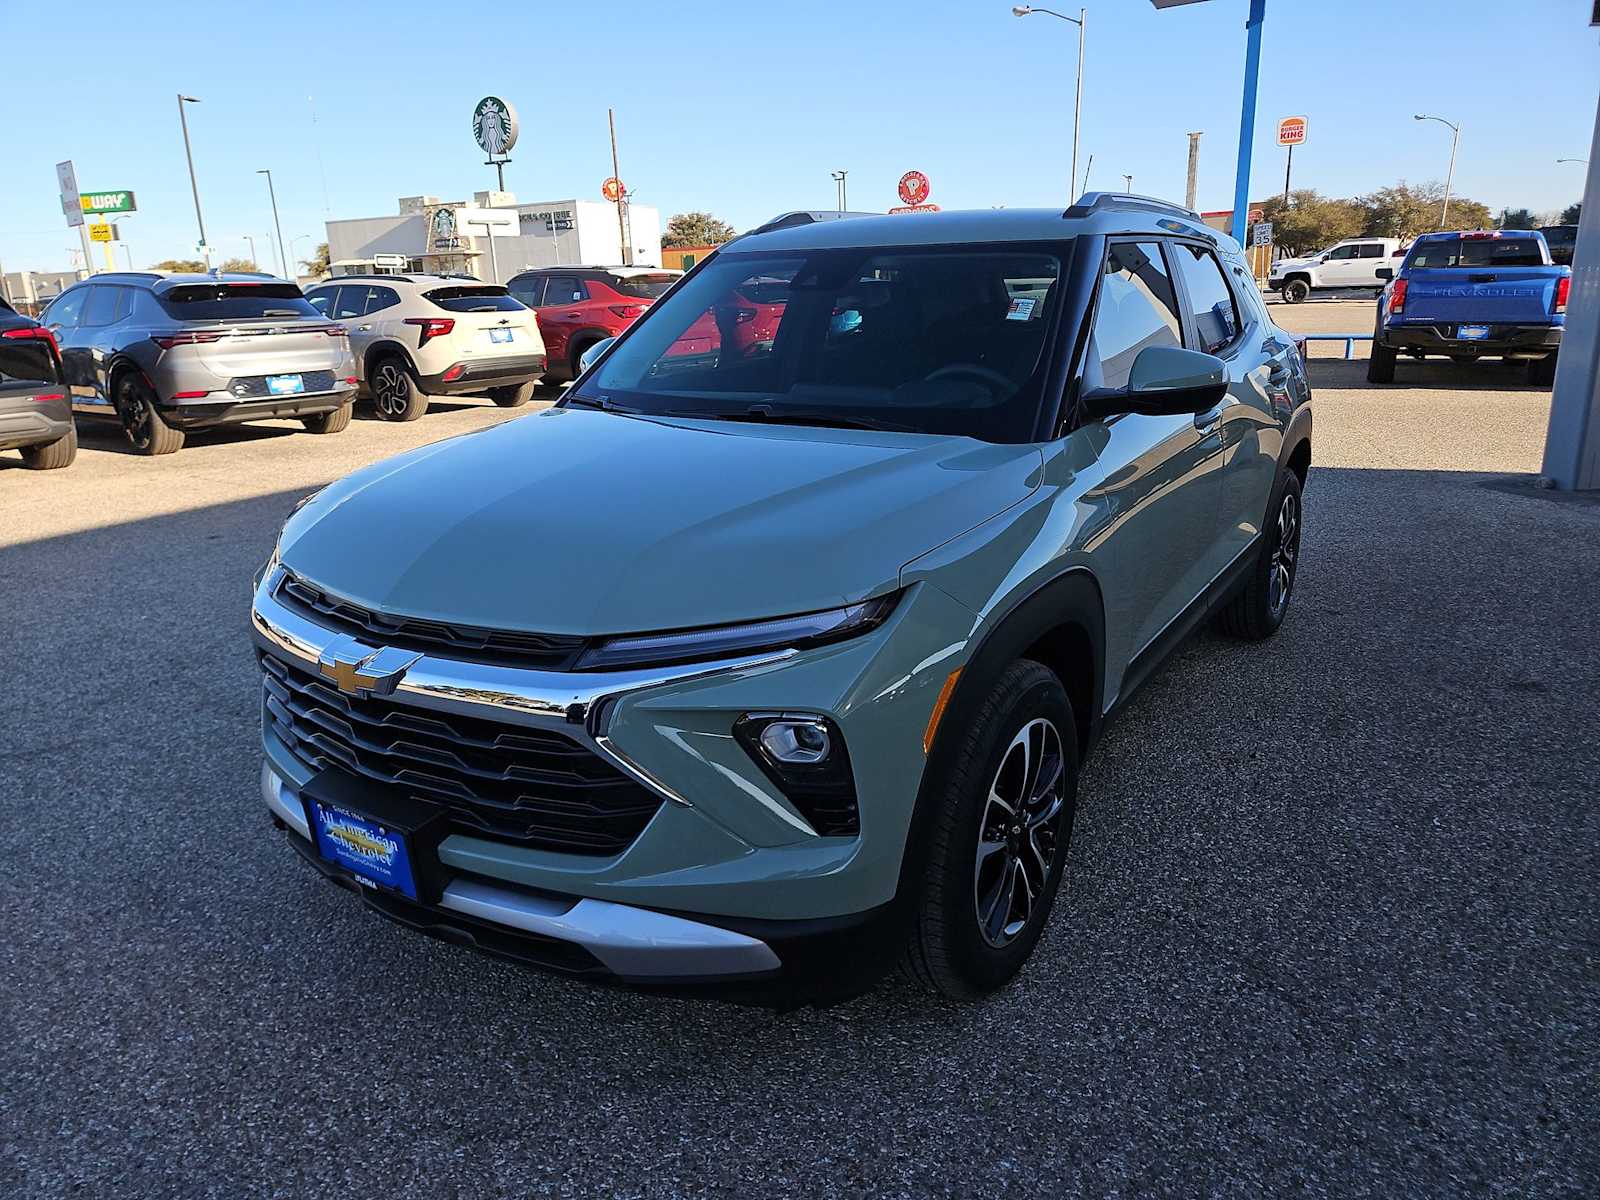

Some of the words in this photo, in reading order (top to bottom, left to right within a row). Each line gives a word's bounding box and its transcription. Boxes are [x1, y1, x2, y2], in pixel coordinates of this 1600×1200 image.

[1280, 131, 1303, 139] KING
[80, 193, 126, 209] BWAY
[1256, 236, 1270, 244] 35
[319, 810, 334, 824] All
[338, 819, 399, 852] American
[331, 831, 393, 866] Chevrolet
